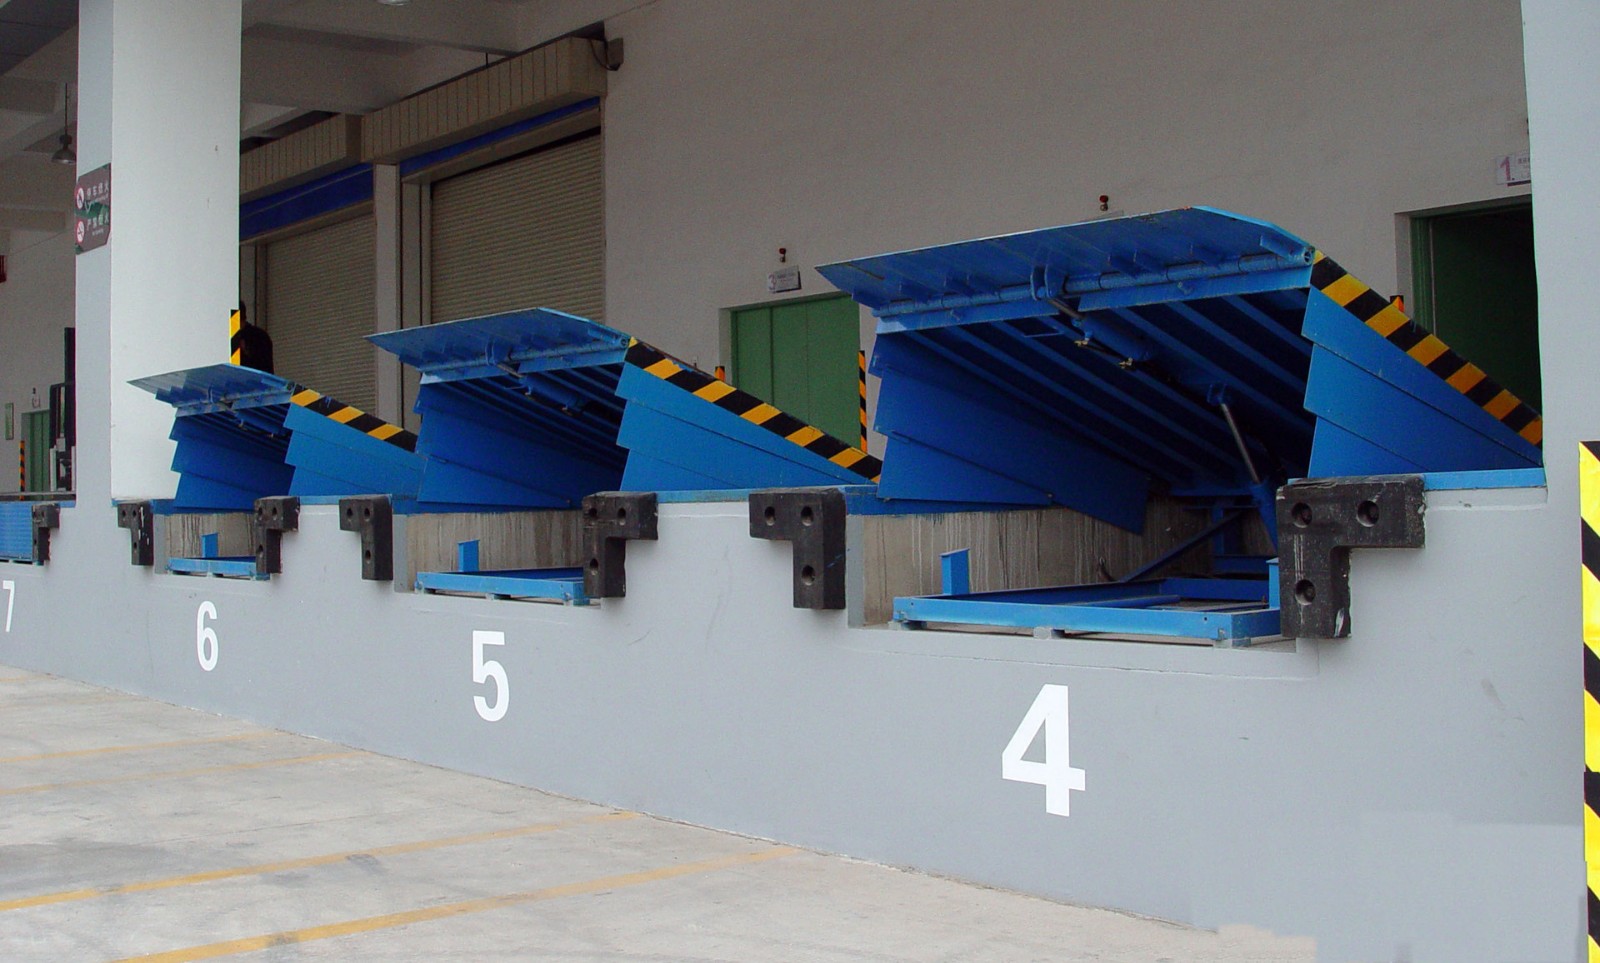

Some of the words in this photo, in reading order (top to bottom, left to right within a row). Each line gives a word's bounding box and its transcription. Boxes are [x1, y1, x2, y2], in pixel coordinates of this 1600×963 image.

[2, 580, 15, 632] 7
[197, 601, 218, 671] 6
[472, 630, 509, 721] 5
[1002, 684, 1085, 816] 4
